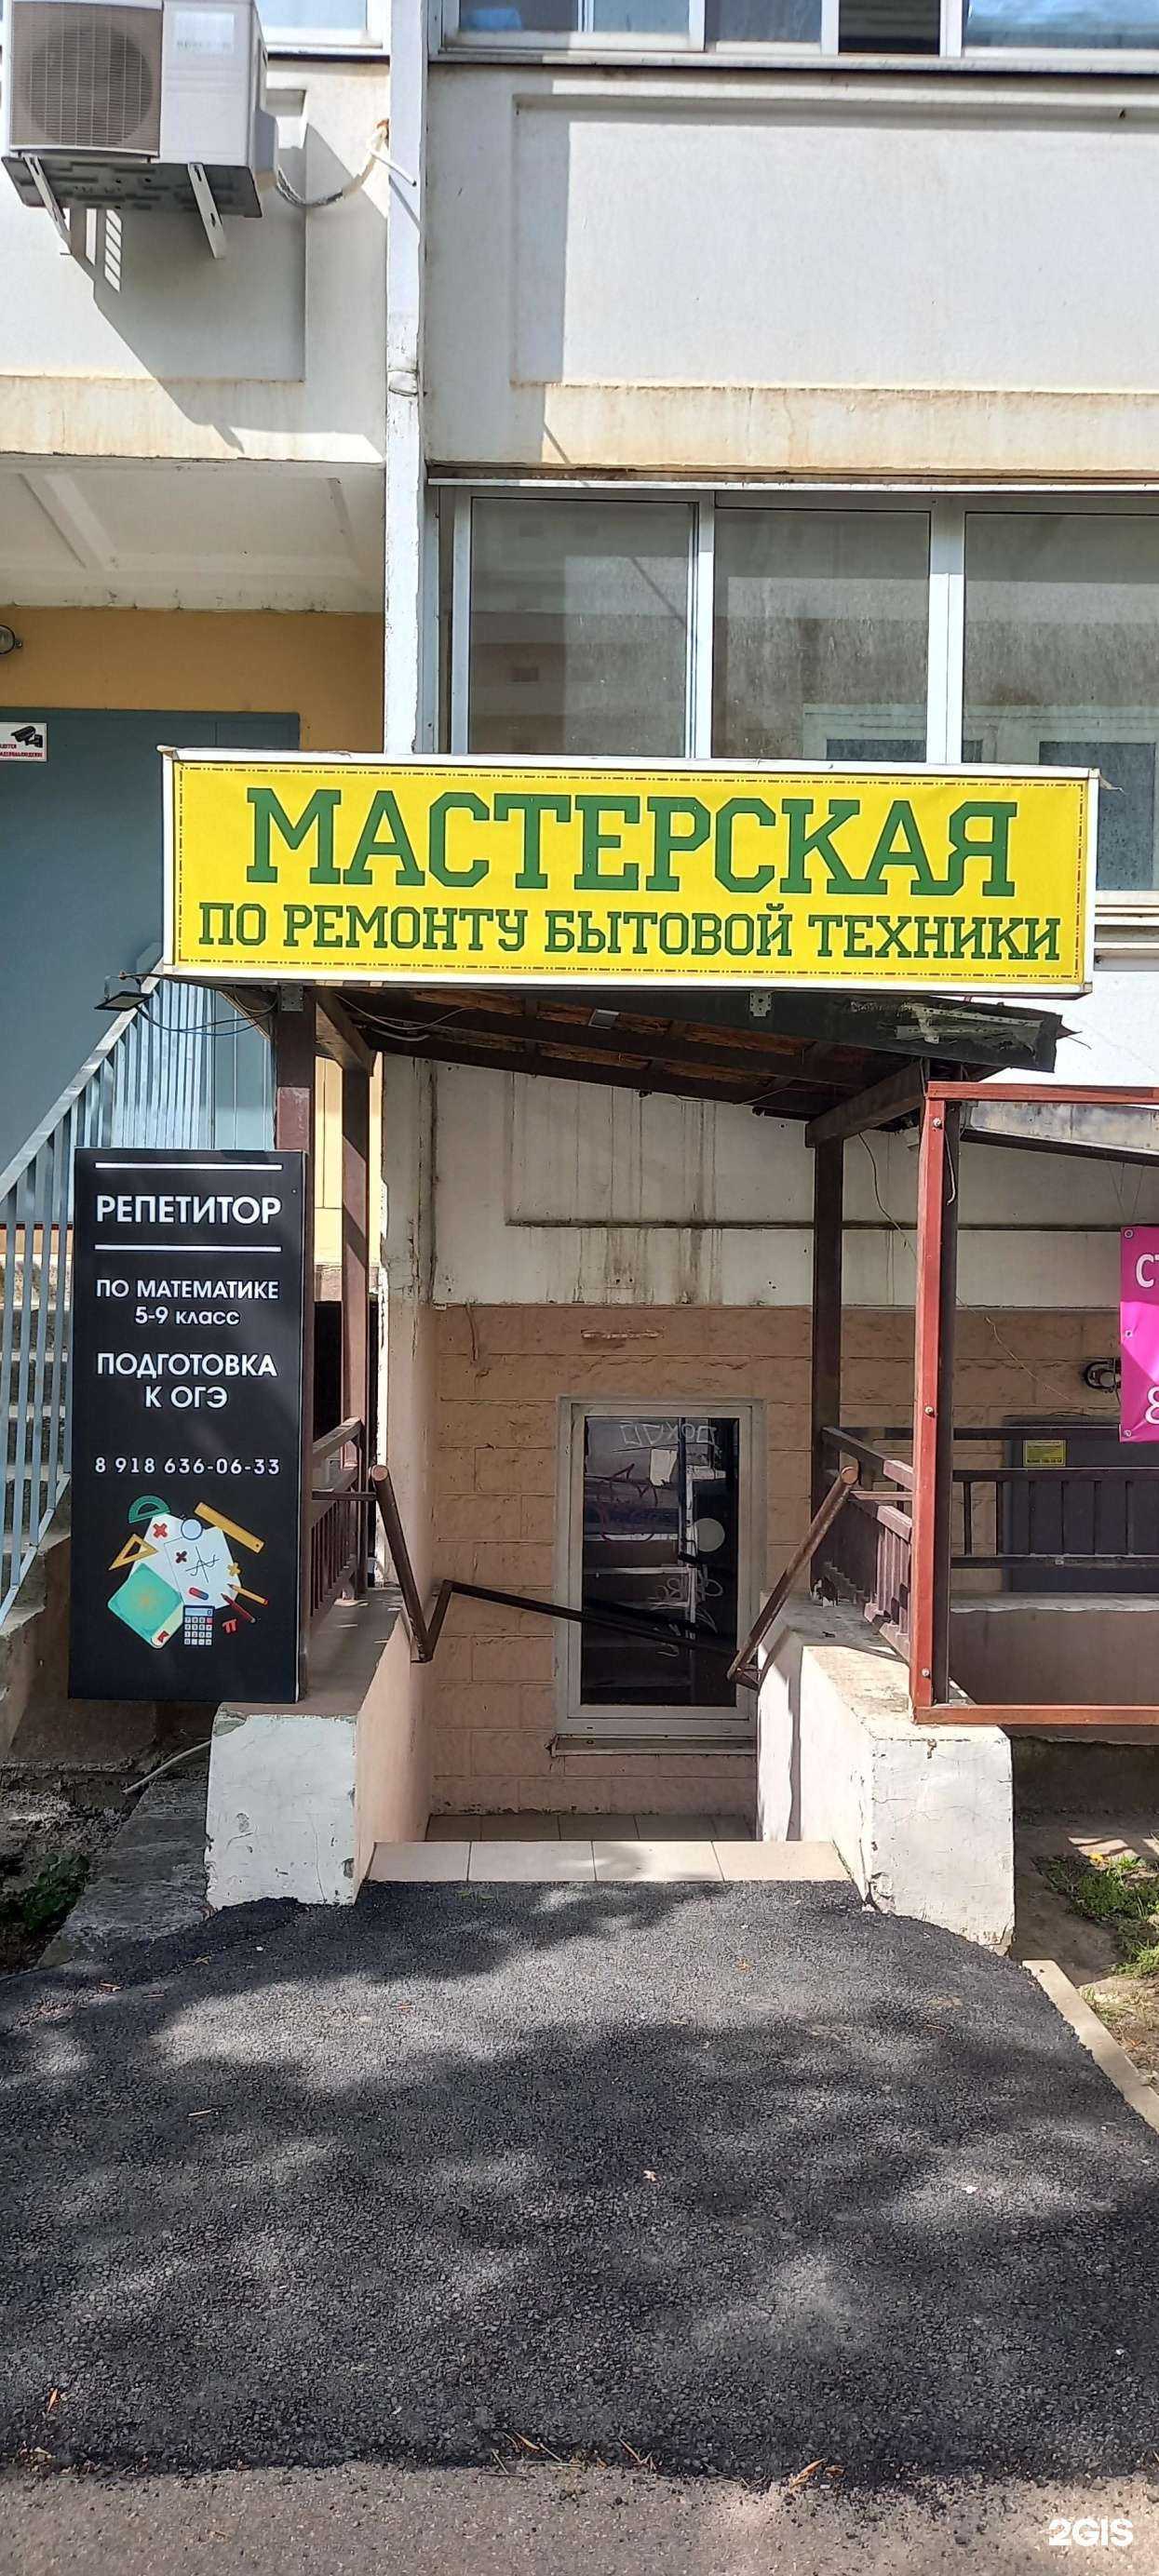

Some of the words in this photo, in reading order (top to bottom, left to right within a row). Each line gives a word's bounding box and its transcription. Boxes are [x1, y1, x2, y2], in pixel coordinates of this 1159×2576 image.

[247, 787, 1017, 896] МАСТЕРСКАЯ
[199, 903, 266, 946] ПО
[283, 905, 528, 951] РЕМОНТУ
[545, 904, 792, 956] БЫТОВОЙ
[808, 915, 1060, 960] ТЕХНИКИ
[97, 1195, 281, 1224] РЕПЕТИТОР
[1136, 1253, 1159, 1288] С
[96, 1279, 129, 1297] ПО
[137, 1281, 278, 1299] МАТЕМАТИКЕ
[135, 1306, 168, 1324] 5-9
[175, 1308, 240, 1325] класс
[97, 1352, 278, 1378] ПОДГОТОВКА
[145, 1386, 162, 1408] К
[170, 1386, 227, 1408] ОГЭ
[95, 1456, 106, 1473] 8
[115, 1457, 155, 1473] 918
[164, 1457, 279, 1474] 636-06-33
